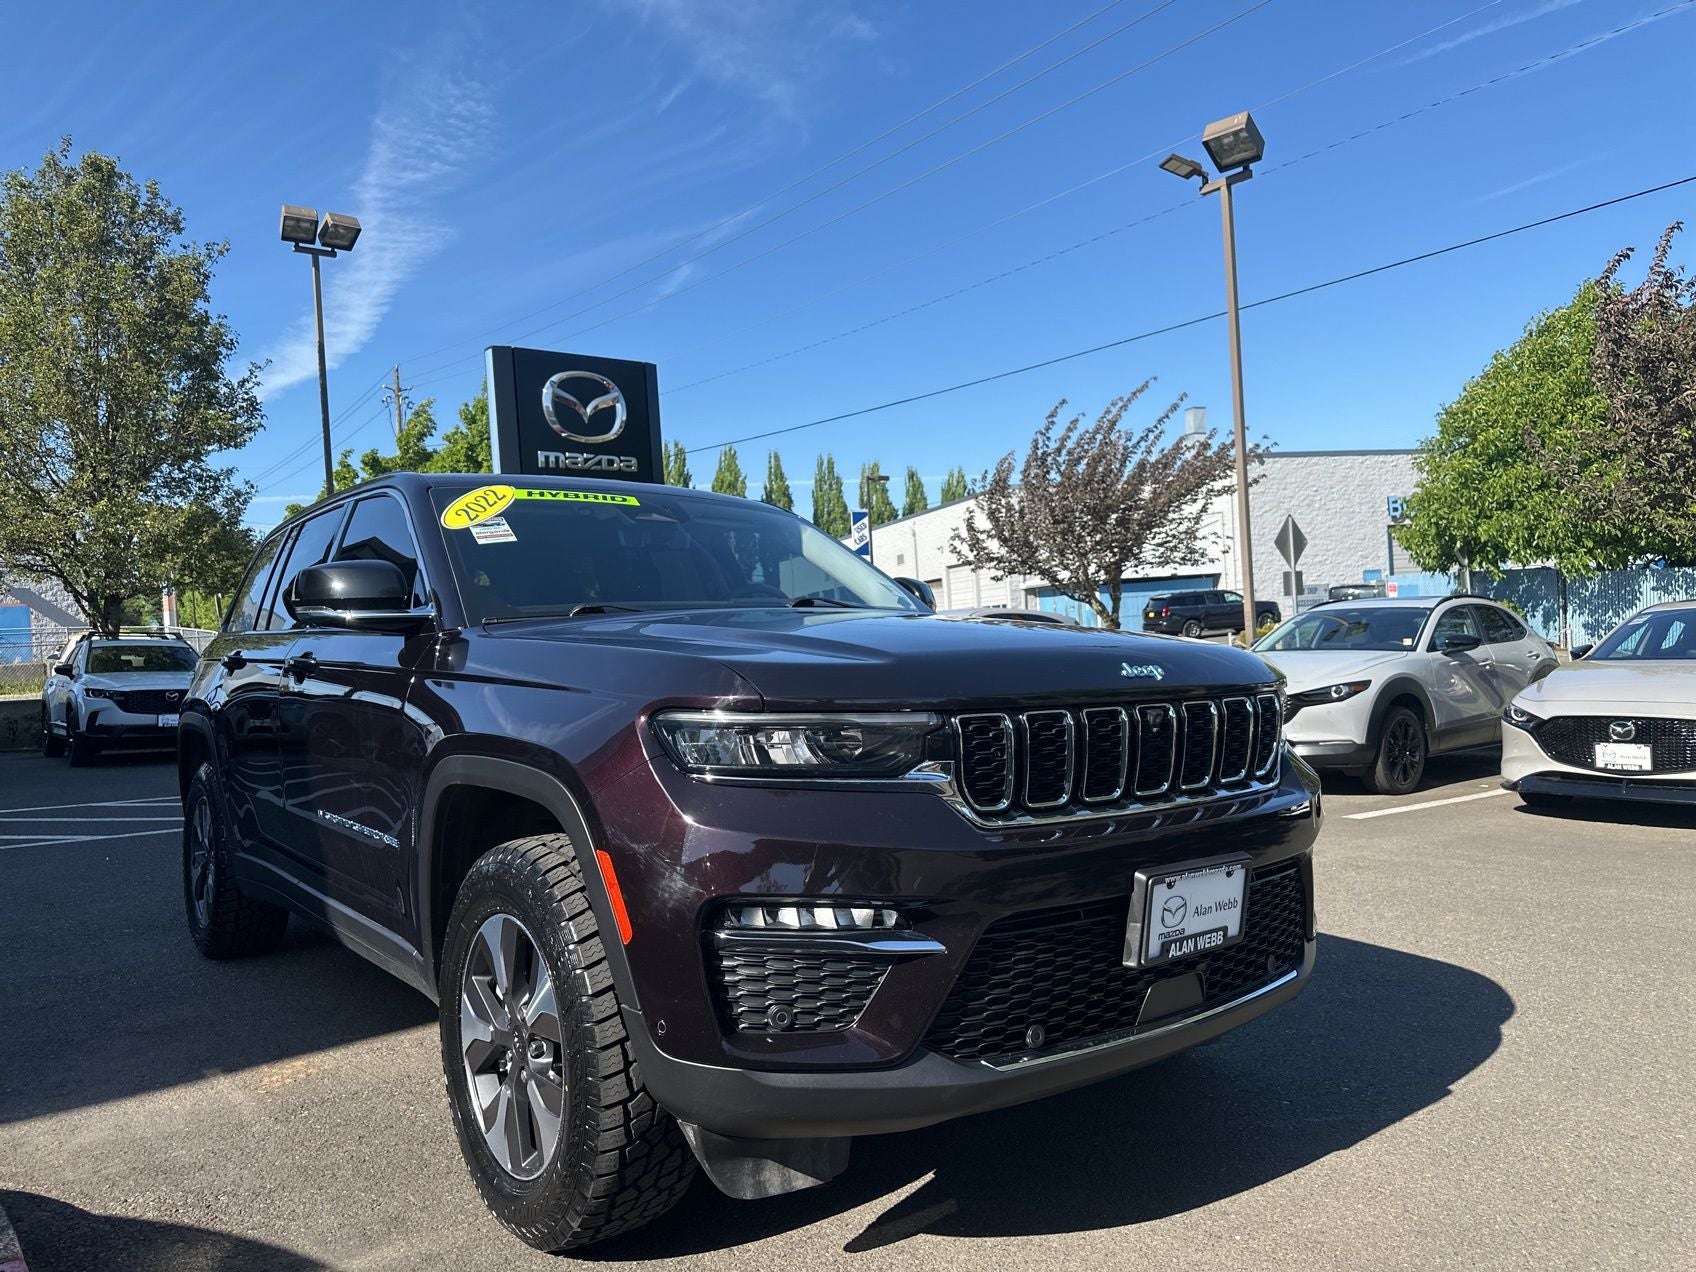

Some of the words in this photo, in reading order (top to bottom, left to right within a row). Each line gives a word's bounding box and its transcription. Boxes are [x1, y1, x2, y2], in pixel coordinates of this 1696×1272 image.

[455, 489, 507, 522] 2022
[527, 490, 628, 502] HYBRID
[1120, 662, 1165, 681] Jeep
[1192, 905, 1213, 918] Alan
[1214, 897, 1239, 913] Webb
[1168, 938, 1195, 959] ALAN
[1196, 930, 1224, 950] WEBB
